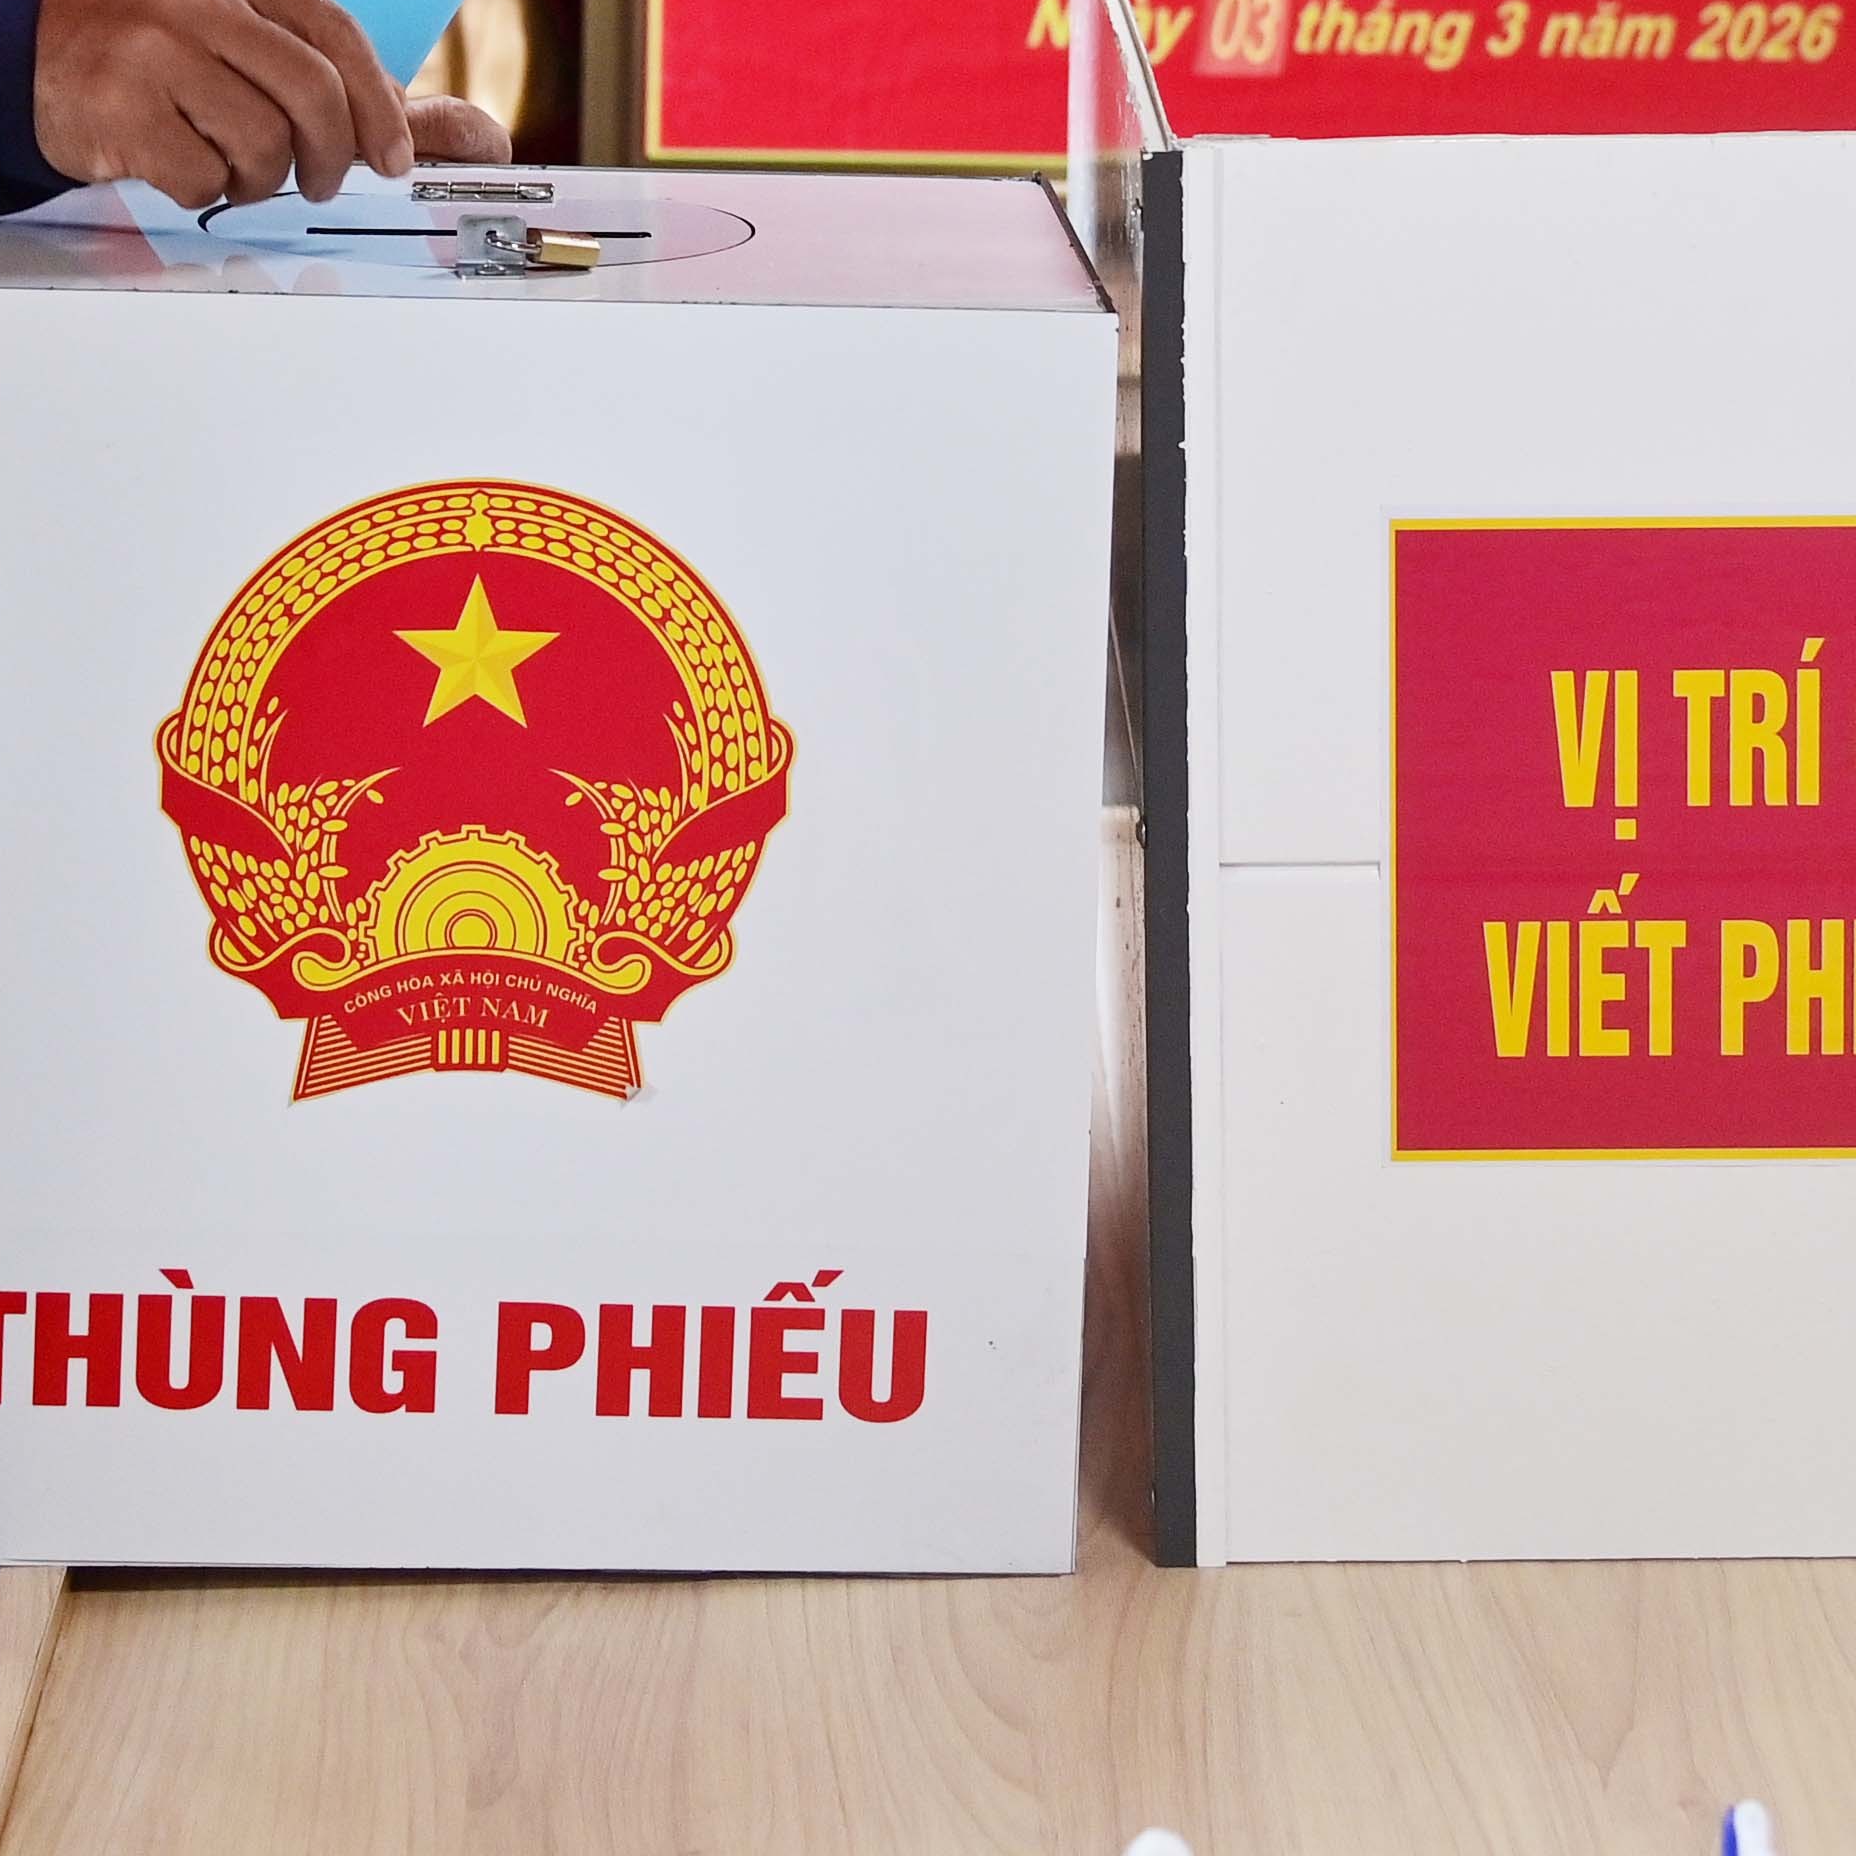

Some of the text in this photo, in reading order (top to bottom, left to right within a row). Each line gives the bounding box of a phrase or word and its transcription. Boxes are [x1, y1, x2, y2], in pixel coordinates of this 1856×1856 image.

[1538, 0, 1679, 60] năm
[1687, 0, 1843, 62] 2026
[1550, 669, 1640, 841] VỊ
[1673, 637, 1825, 807] TRÍ
[396, 991, 550, 1029] VIỆT NAM
[440, 968, 465, 986] XÃ
[470, 968, 500, 990] HỘI
[1482, 872, 1687, 1058] VIẾT
[494, 1269, 929, 1424] PHIẾU
